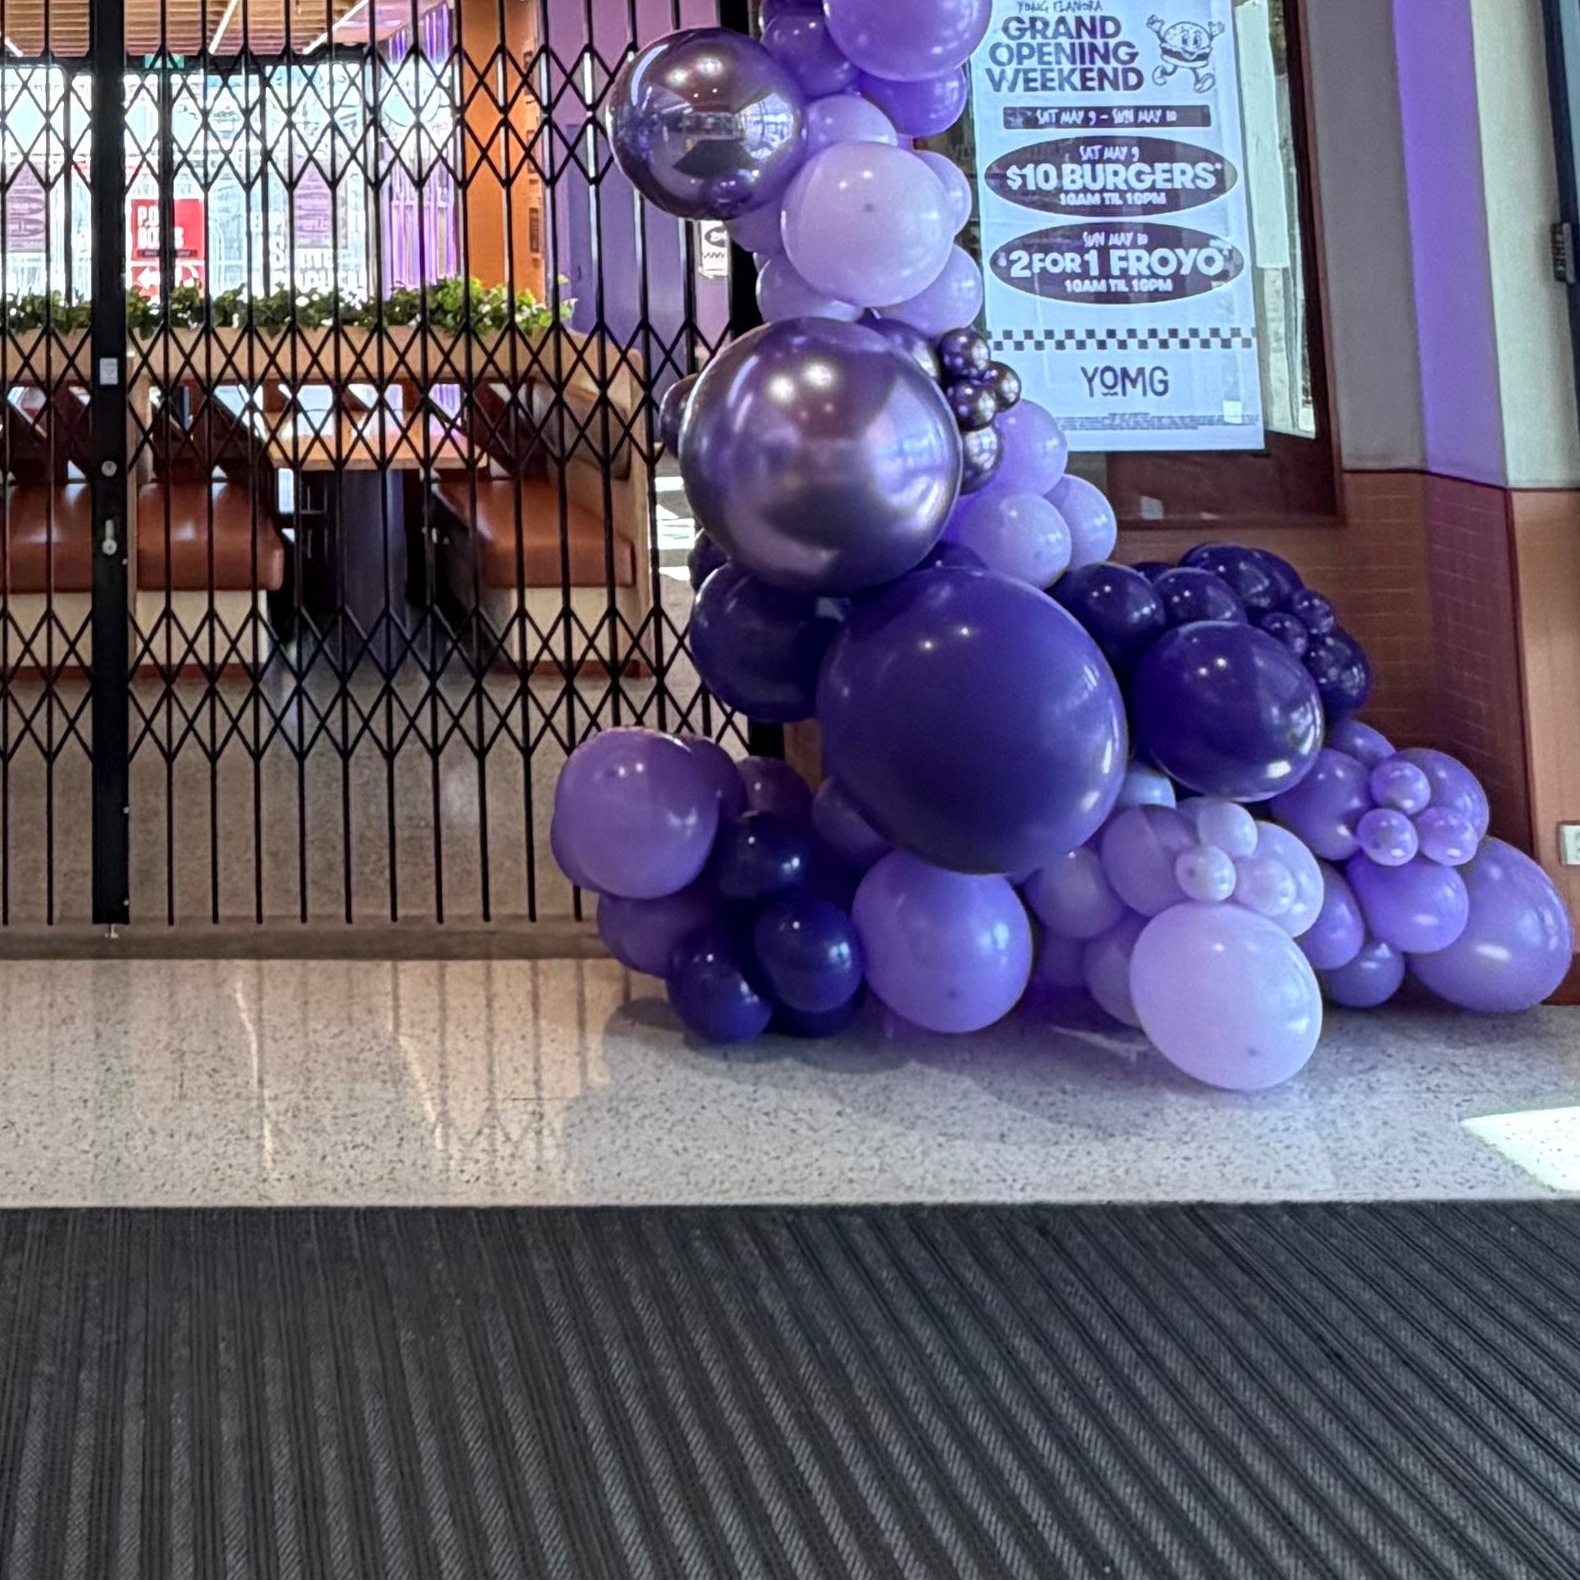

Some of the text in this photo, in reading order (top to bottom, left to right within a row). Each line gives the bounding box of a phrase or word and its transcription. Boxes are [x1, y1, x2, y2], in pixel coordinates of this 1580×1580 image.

[1001, 15, 1122, 41] GRAND
[988, 41, 1140, 67] OPENING
[984, 67, 1145, 93] WEEKEND
[1035, 108, 1060, 125] SAT
[1060, 108, 1085, 125] MAY
[1087, 109, 1097, 126] 9
[1137, 108, 1163, 124] MAY
[1079, 144, 1140, 162] SAT MAY 9
[1006, 162, 1058, 191] $10
[1059, 192, 1102, 206] 10AM
[1125, 191, 1168, 206] 10PM
[1082, 230, 1106, 248] SUN
[1108, 231, 1134, 247] MAY
[1063, 278, 1108, 293] 10AM
[1131, 277, 1173, 292] 10PM
[1080, 364, 1170, 398] YOMG
